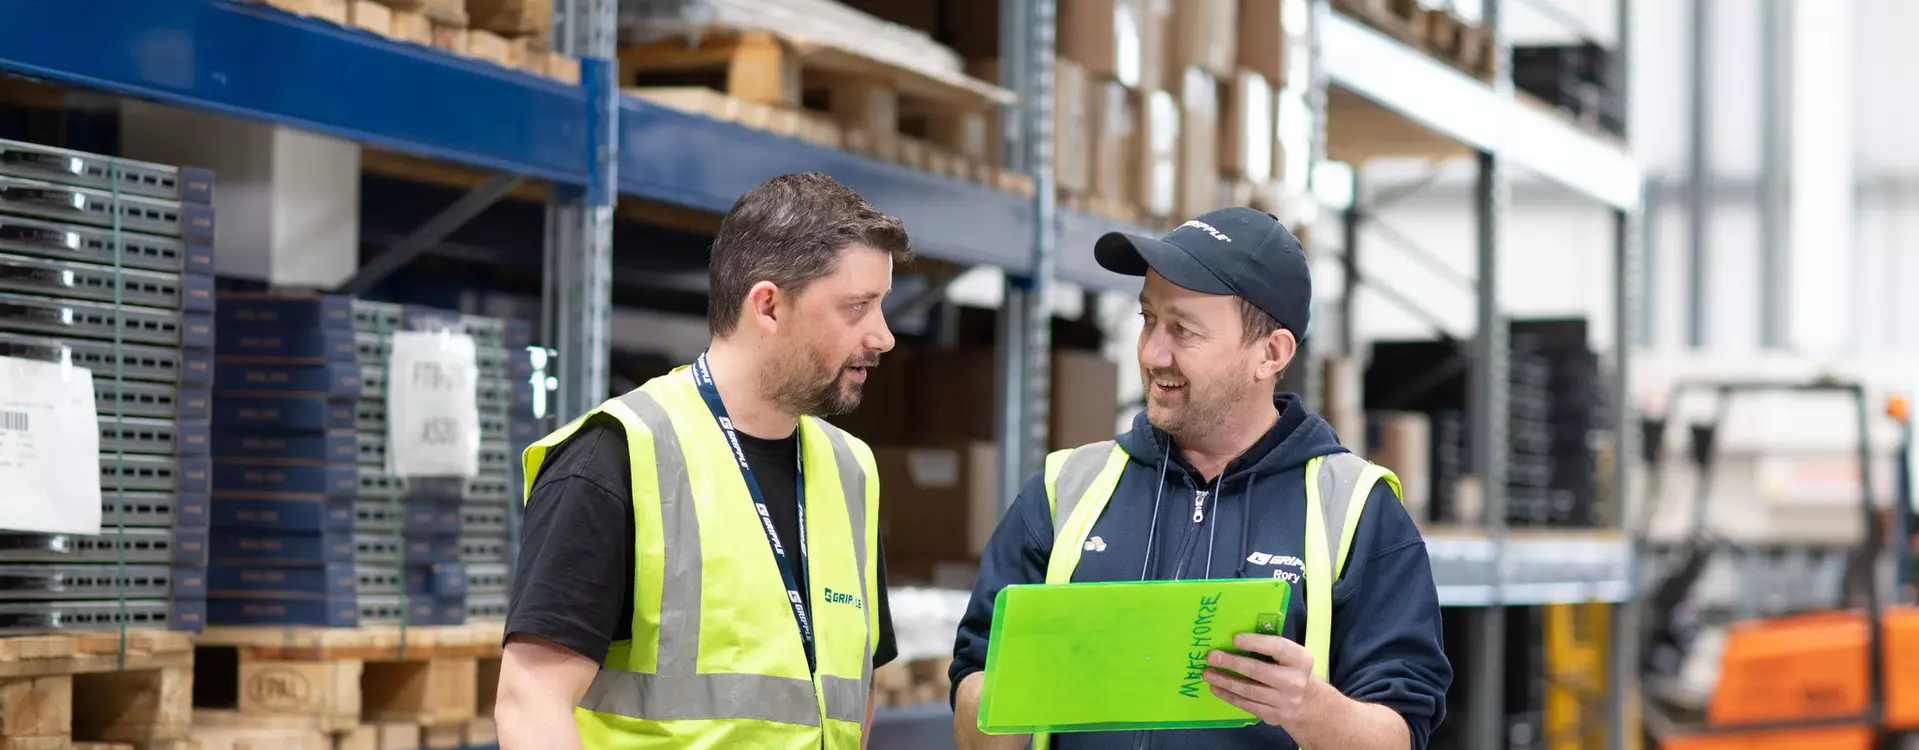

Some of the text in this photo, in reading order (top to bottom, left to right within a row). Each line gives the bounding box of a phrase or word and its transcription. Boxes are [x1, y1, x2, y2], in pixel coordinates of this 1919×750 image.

[763, 516, 784, 556] GRIPPLE
[1273, 569, 1300, 584] Rory
[795, 603, 811, 642] GRIPPLE
